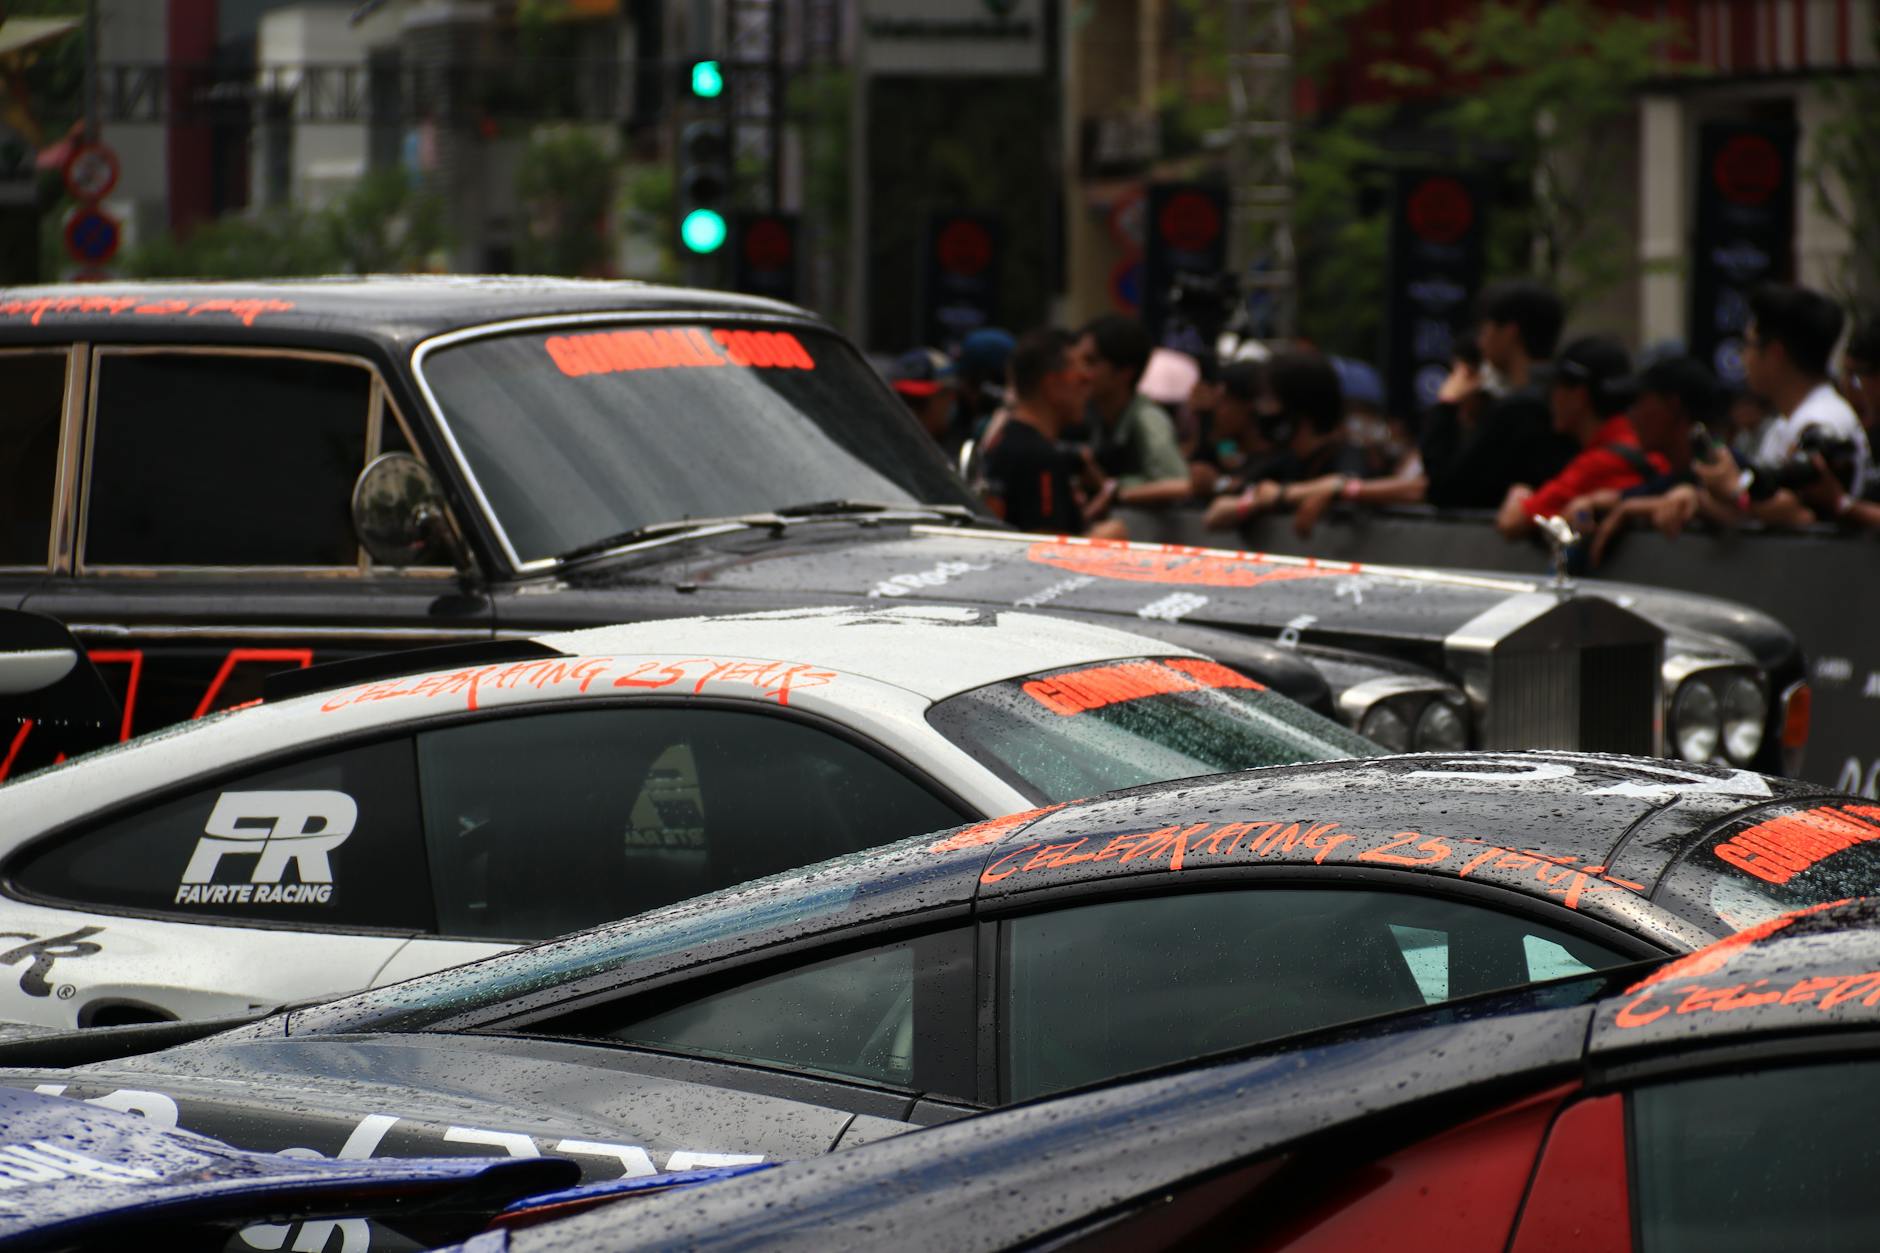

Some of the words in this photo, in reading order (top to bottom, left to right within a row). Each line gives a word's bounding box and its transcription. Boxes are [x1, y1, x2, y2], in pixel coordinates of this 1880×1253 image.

[613, 658, 706, 690] 25
[693, 660, 838, 706] YEARS
[181, 789, 358, 884] FR
[1358, 831, 1452, 867] 25
[174, 884, 254, 904] FAVRTE
[252, 884, 333, 904] RACING
